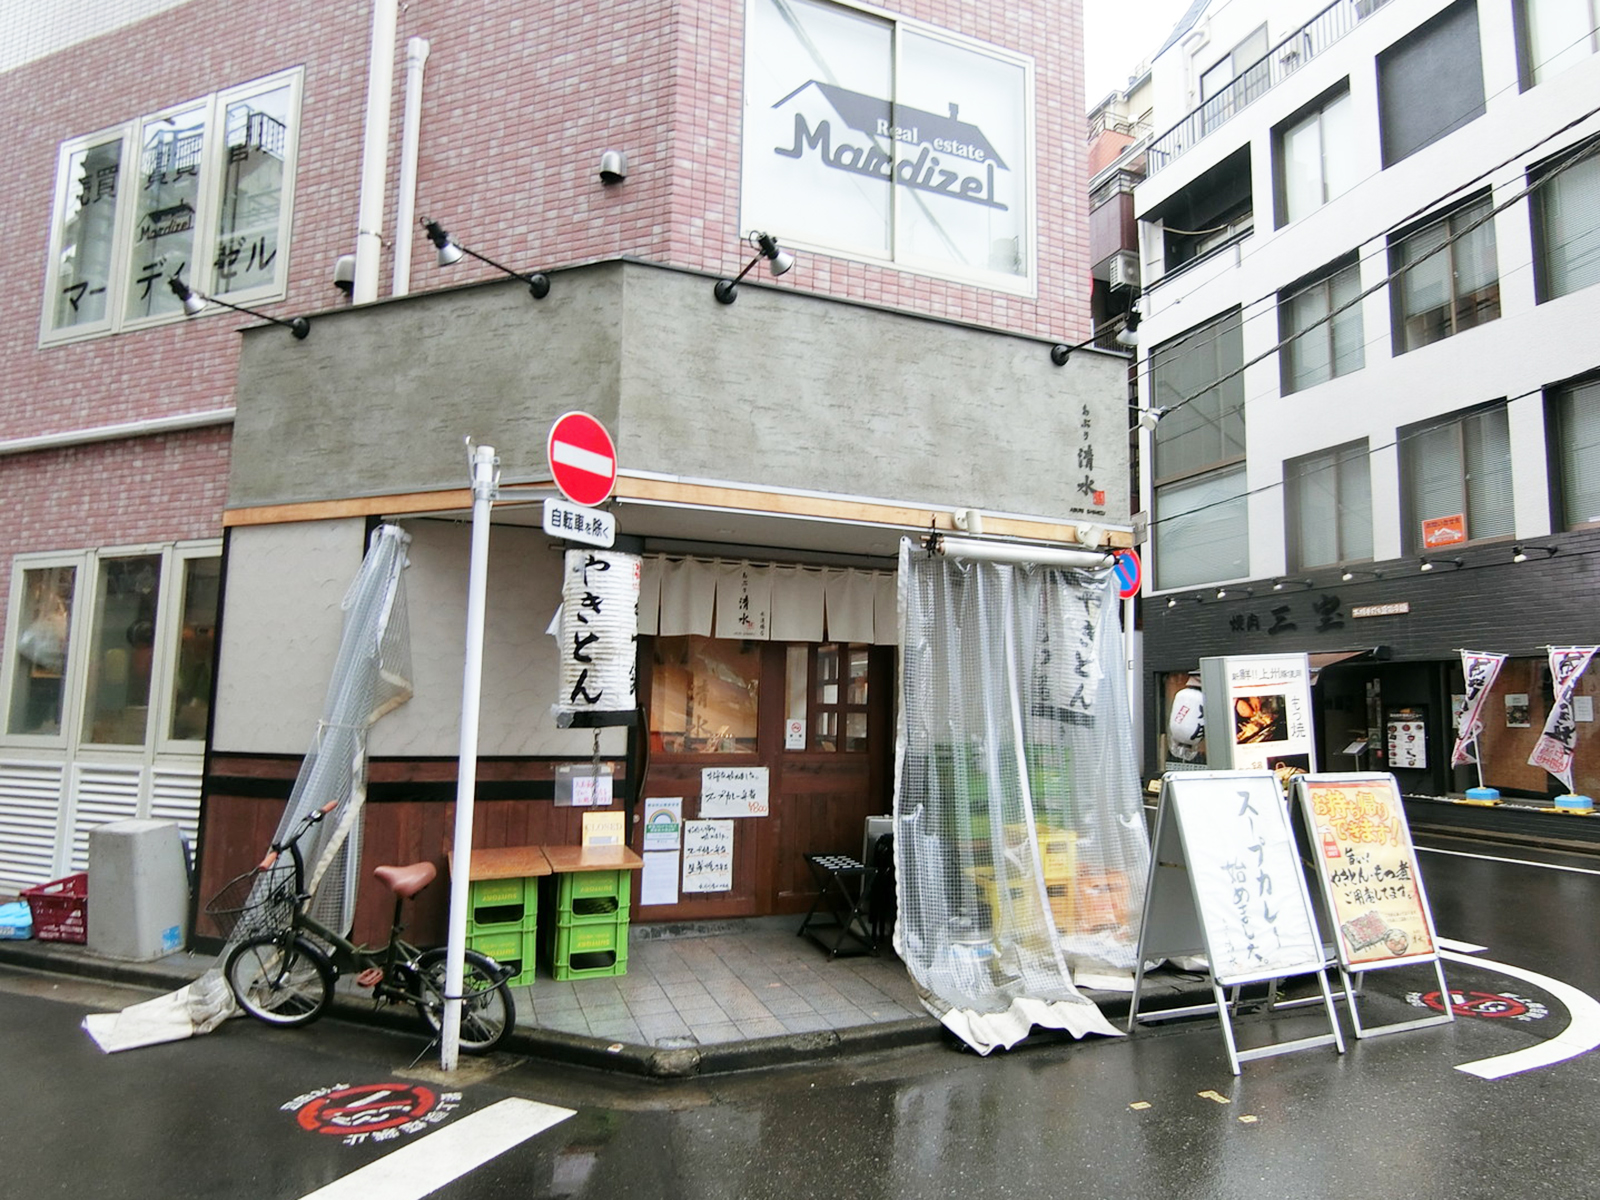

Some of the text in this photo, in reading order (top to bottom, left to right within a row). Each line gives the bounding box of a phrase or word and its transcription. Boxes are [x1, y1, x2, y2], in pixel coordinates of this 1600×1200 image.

[876, 118, 985, 161] Real estate
[551, 508, 609, 539] 自転車を除く
[1290, 694, 1306, 738] もつ焼
[1312, 789, 1390, 822] お持ち帰り
[1329, 816, 1399, 847] できます!
[1236, 790, 1281, 948] スープカレー
